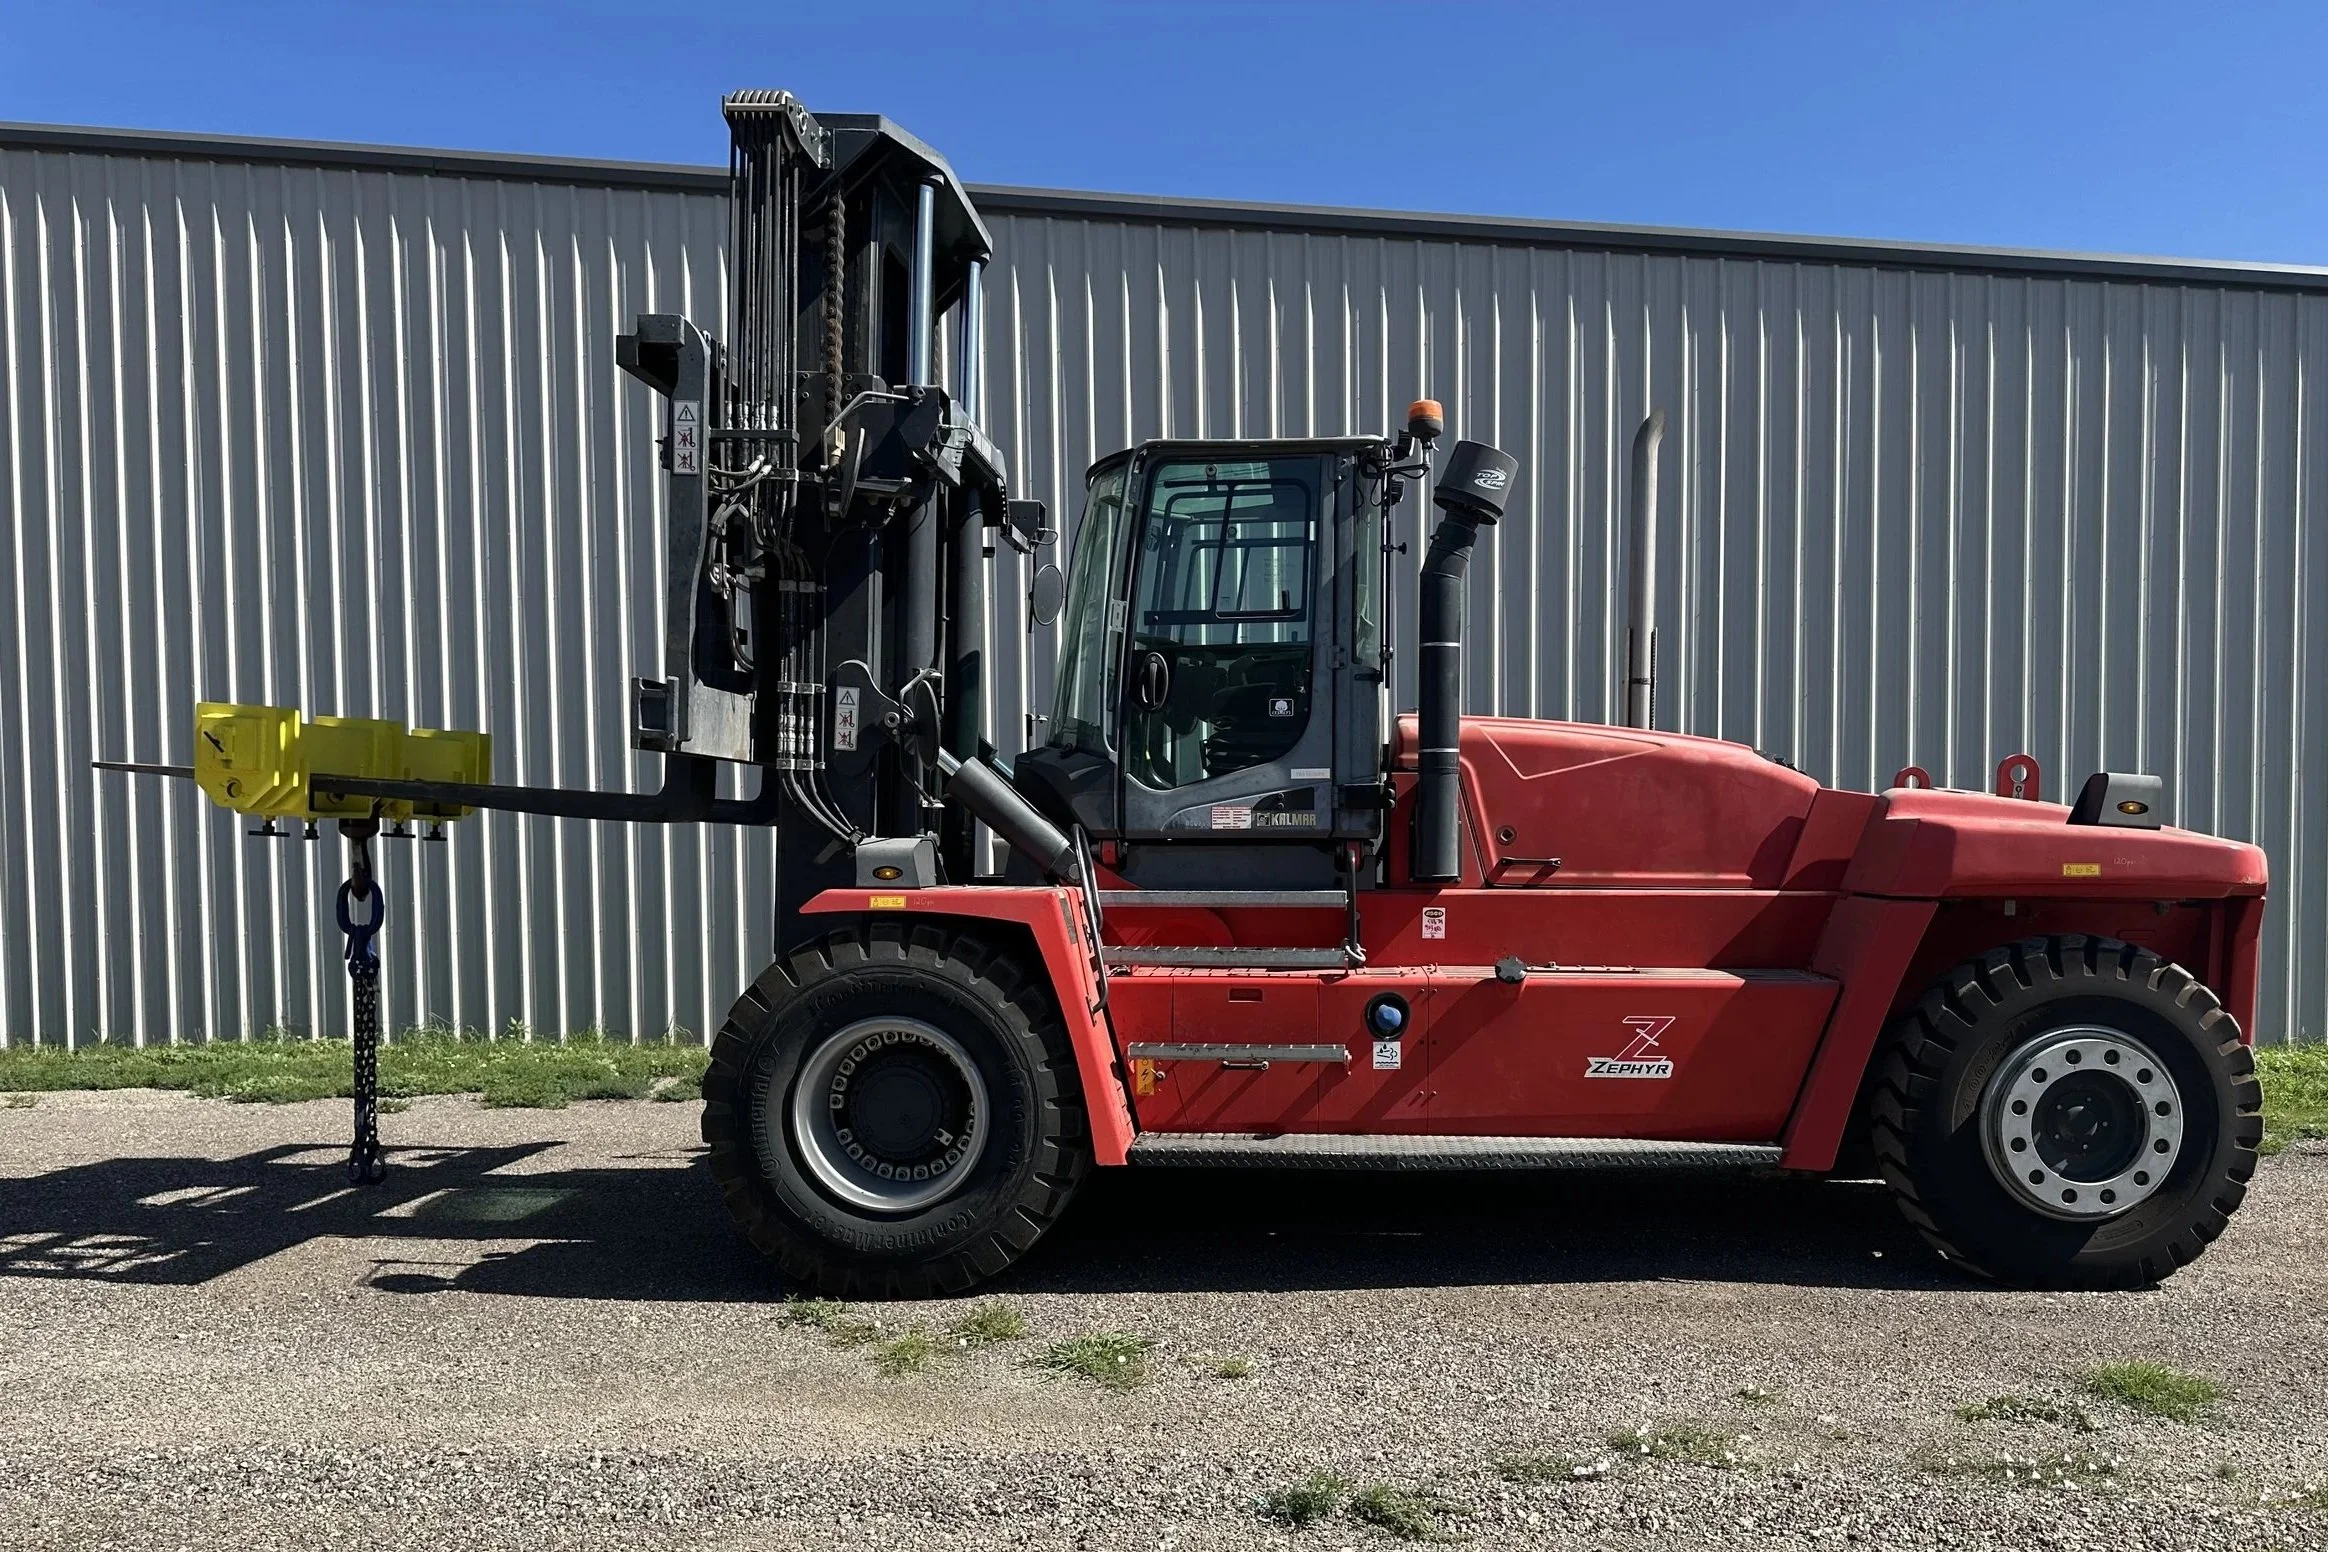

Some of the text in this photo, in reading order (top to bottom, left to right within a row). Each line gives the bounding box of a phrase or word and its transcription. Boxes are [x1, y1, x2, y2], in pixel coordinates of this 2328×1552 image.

[1486, 479, 1506, 487] SPIN
[1271, 812, 1317, 826] KALMAR
[1591, 1061, 1670, 1075] ZEPHYR
